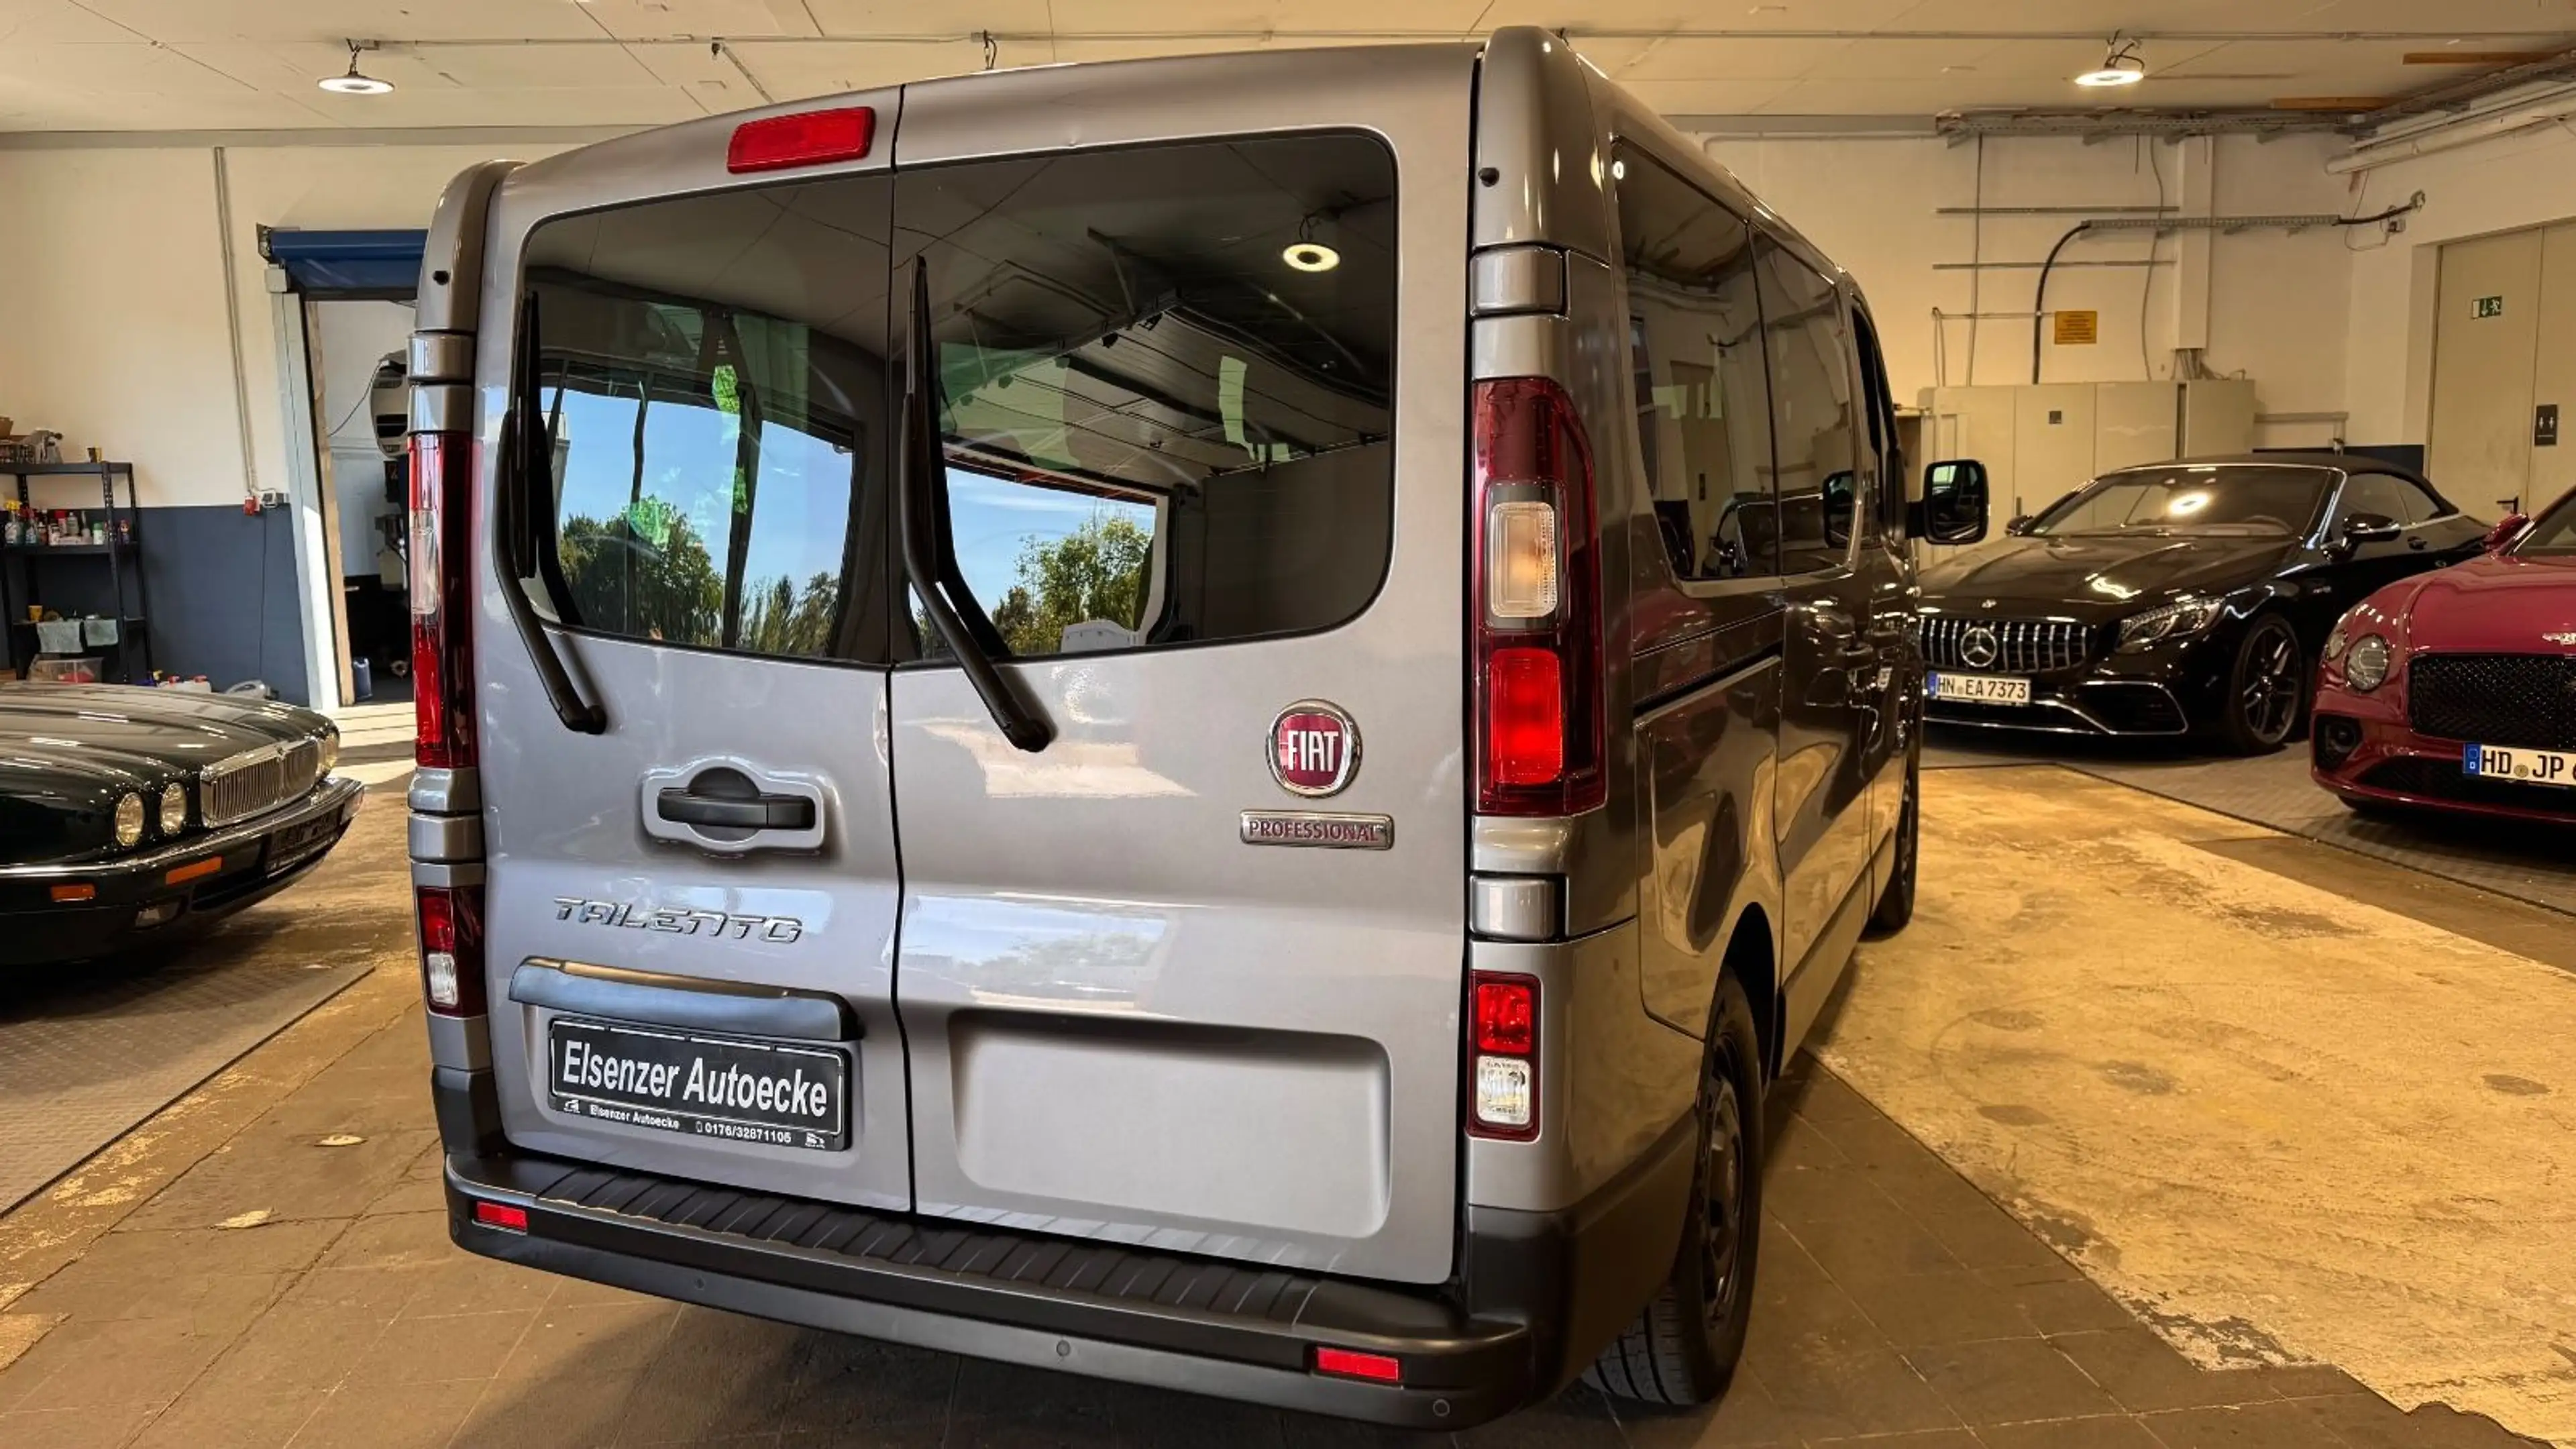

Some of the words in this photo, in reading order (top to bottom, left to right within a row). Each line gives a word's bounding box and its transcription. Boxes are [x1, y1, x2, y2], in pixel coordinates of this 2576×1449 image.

[1938, 677, 1955, 694] HN
[1966, 680, 1984, 696] EA
[1988, 681, 2027, 699] 7373
[1287, 731, 1339, 771] FIAT
[2481, 750, 2512, 774] HD
[2532, 755, 2564, 779] JP
[1248, 820, 1379, 842] PROFESSIONAL
[554, 896, 804, 944] TALENTO
[562, 1040, 680, 1098] Elsenzer
[682, 1057, 827, 1117] Autoecke
[589, 1104, 630, 1122] Elsenzer
[633, 1112, 680, 1130] Autoecke
